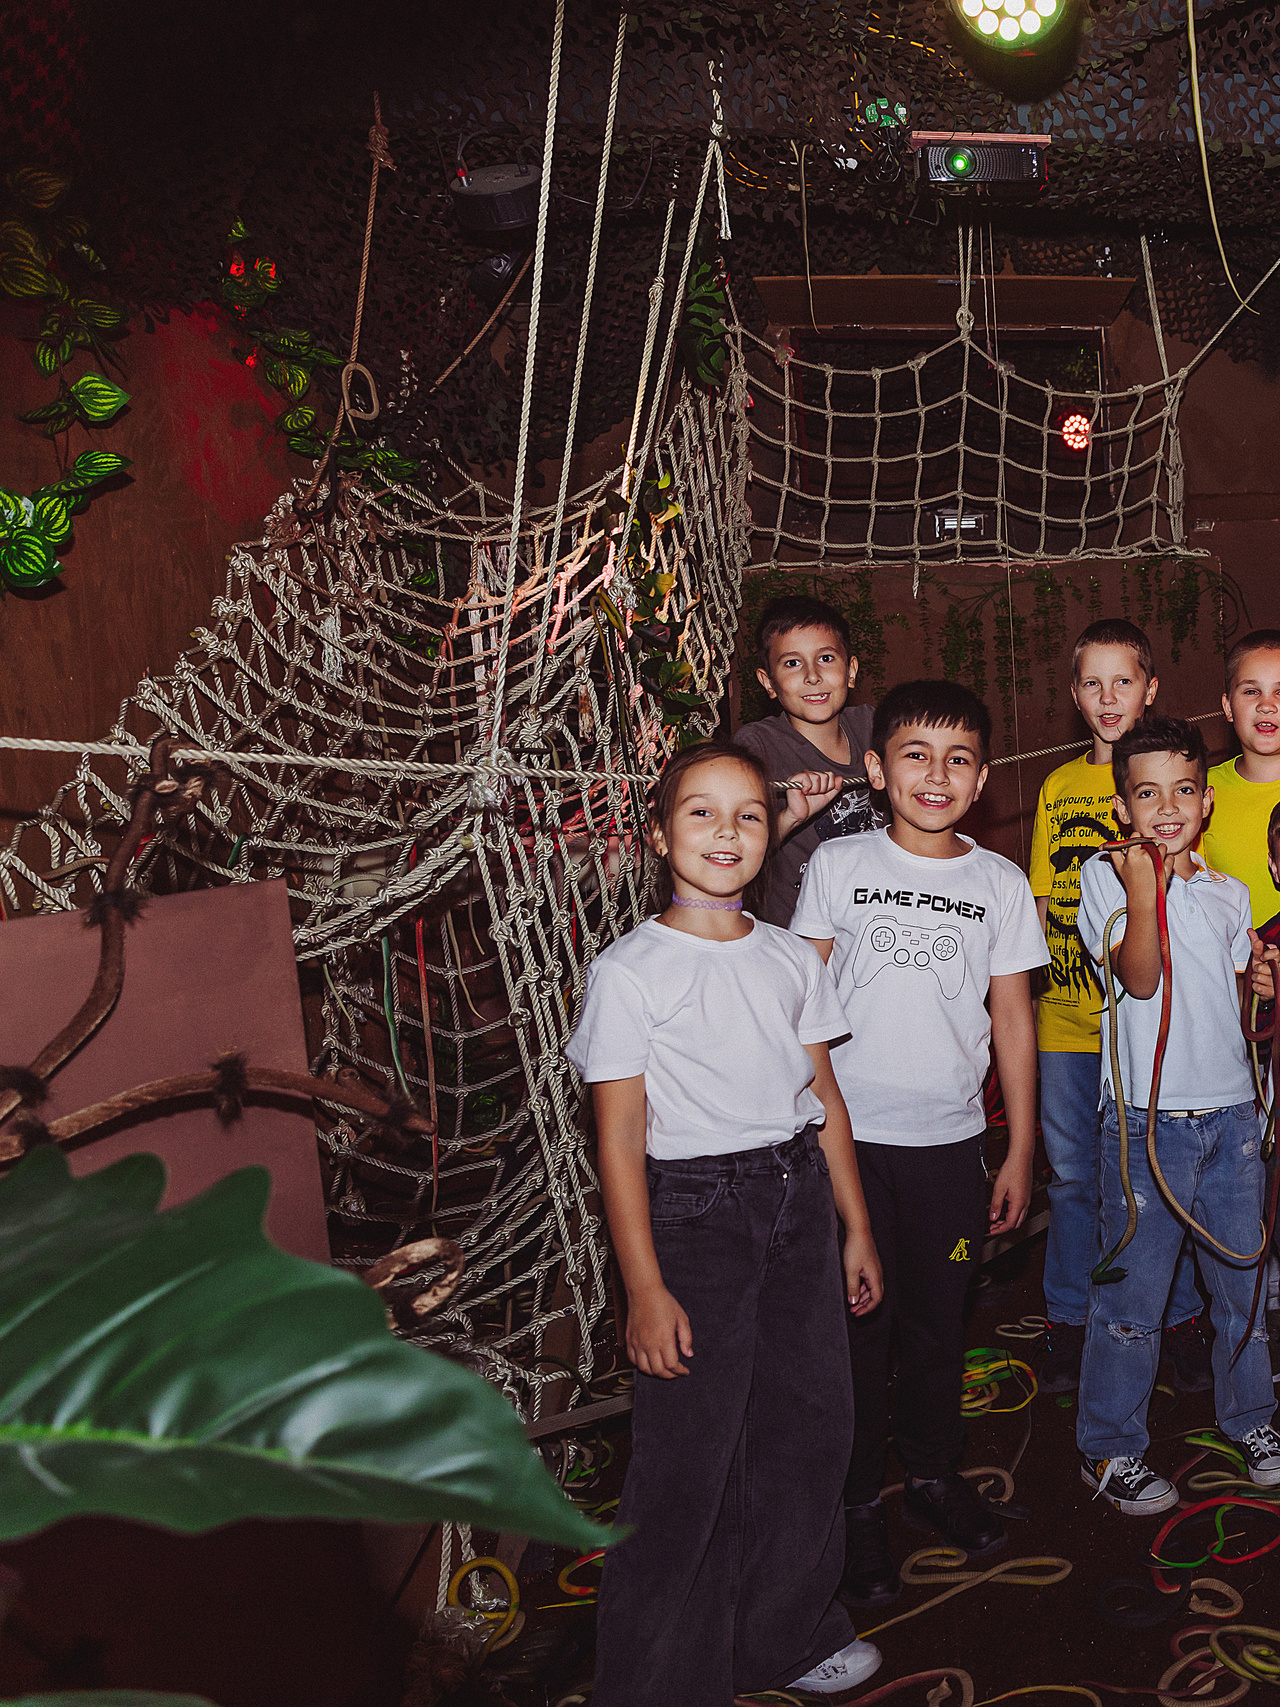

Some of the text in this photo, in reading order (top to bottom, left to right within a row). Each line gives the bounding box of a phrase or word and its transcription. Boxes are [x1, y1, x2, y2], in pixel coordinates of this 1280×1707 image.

[1062, 795, 1095, 807] young,
[1098, 795, 1112, 803] we
[1095, 811, 1108, 820] we
[1079, 828, 1095, 838] our
[853, 887, 987, 923] GAME POWER
